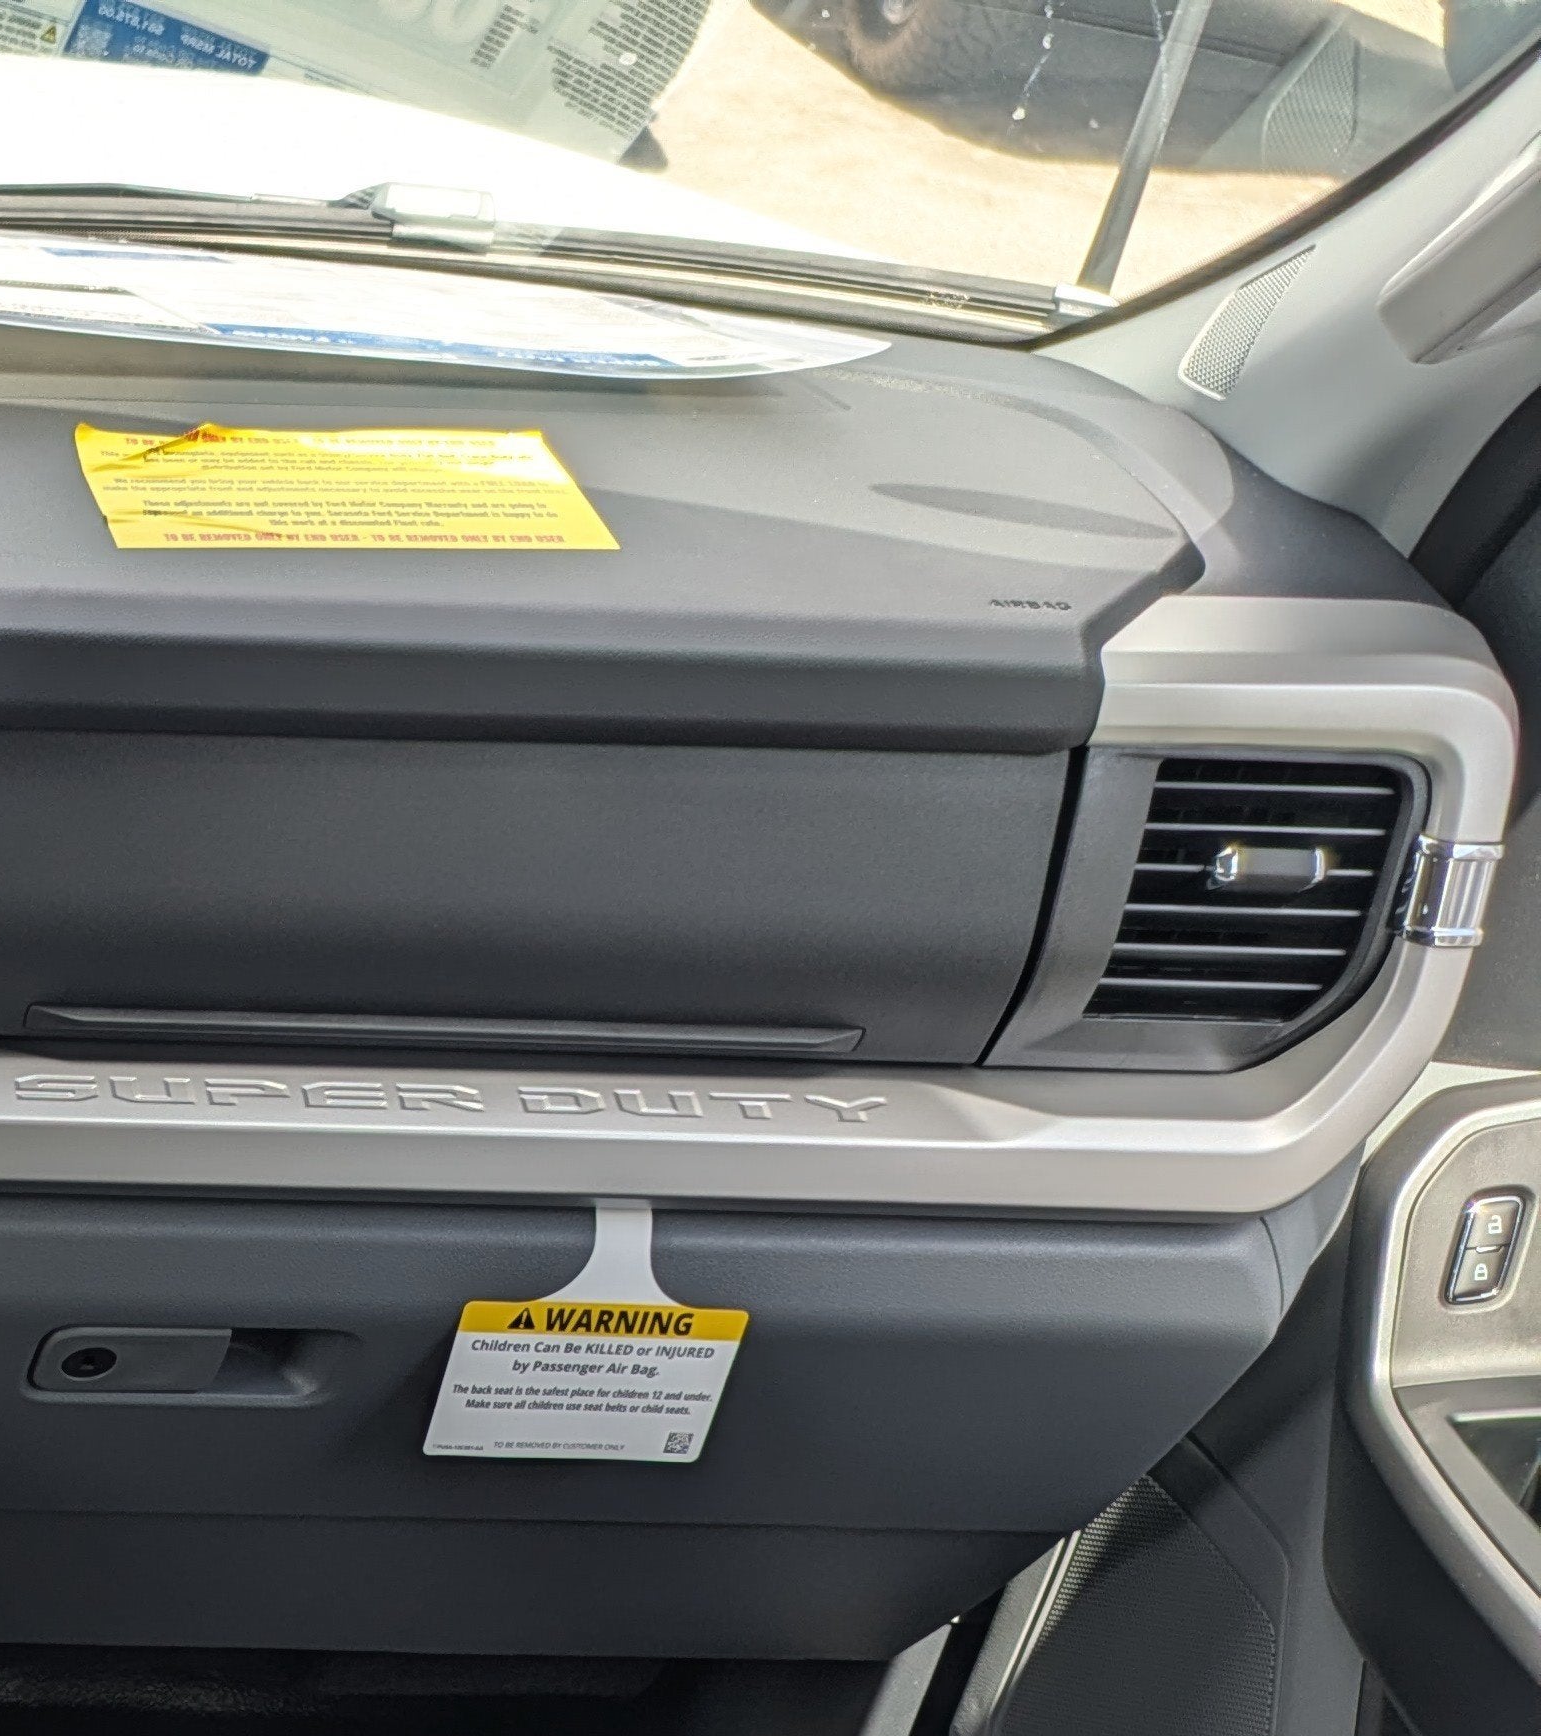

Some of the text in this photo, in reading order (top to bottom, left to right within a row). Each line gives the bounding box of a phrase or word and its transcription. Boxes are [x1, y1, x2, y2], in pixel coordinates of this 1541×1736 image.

[12, 1073, 891, 1124] SUPER DUTY
[545, 1307, 695, 1336] WARNING
[471, 1340, 715, 1360] Children Can Be KILLED or INJURED
[512, 1359, 660, 1378] by Passenger Air Bag.
[453, 1384, 713, 1402] The back seat is the safest place for children 12 and under.
[465, 1399, 691, 1415] Make sure all children use seat belts or child seats.
[516, 1441, 551, 1449] REMOVED
